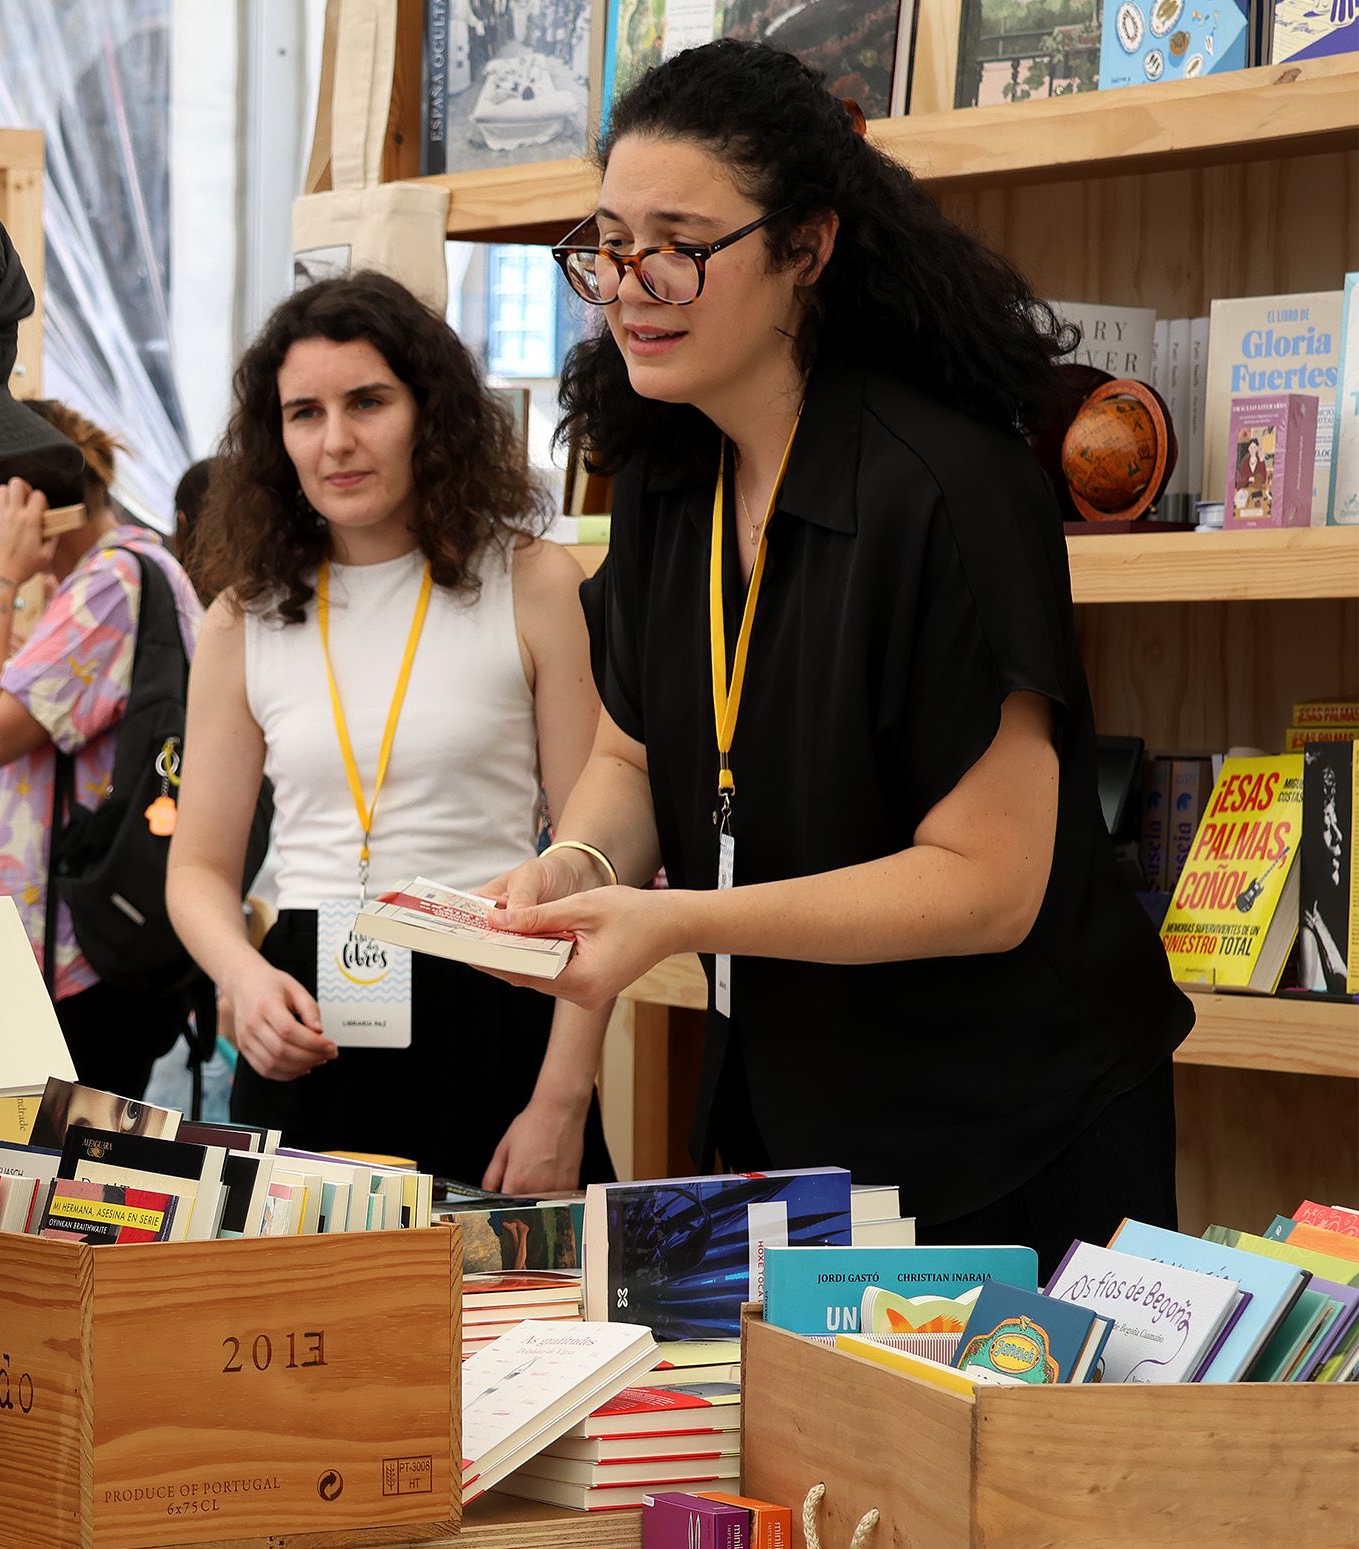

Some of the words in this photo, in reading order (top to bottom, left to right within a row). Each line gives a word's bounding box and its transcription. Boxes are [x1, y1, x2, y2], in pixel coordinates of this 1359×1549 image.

[430, 75, 444, 142] ESPAÑA
[1276, 309, 1299, 322] LIBRO
[1300, 308, 1310, 321] DE
[1241, 326, 1332, 360] Gloria
[1230, 363, 1339, 394] Fuertes
[1210, 771, 1280, 819] ¡ESAS
[1283, 777, 1304, 791] MIGU
[1193, 820, 1292, 869] PALMAS,
[1176, 864, 1248, 911] COÑO!
[1241, 925, 1249, 935] DE
[1250, 926, 1261, 937] UN
[1163, 934, 1218, 955] SINIESTRO
[1219, 936, 1253, 957] TOTAL
[16, 1096, 28, 1133] ndrade
[48, 1218, 72, 1229] OYINKAN
[72, 1222, 108, 1235] BRAITHWAITE
[52, 1202, 62, 1210] MI
[62, 1202, 95, 1217] HERMANA,
[96, 1208, 126, 1221] ASESINA
[127, 1212, 139, 1223] EN
[139, 1214, 160, 1227] SERIE
[757, 1241, 765, 1268] HOXE
[757, 1270, 765, 1297] TOCA
[817, 1273, 846, 1284] JORDI
[847, 1271, 880, 1284] GASTÓ
[897, 1272, 950, 1284] CHRISTIAN
[951, 1272, 992, 1284] INARAJA
[1066, 1274, 1095, 1301] Os
[1096, 1270, 1123, 1300] fíos
[1125, 1275, 1145, 1302] de
[1143, 1281, 1193, 1332] Begoña
[826, 1305, 858, 1331] UN
[398, 1459, 432, 1474] PT-3008
[105, 1485, 175, 1504] PRODUCE
[179, 1483, 199, 1498] OF
[203, 1476, 282, 1496] PORTUGAL
[408, 1477, 421, 1490] HT
[166, 1499, 221, 1516] 6x75CL
